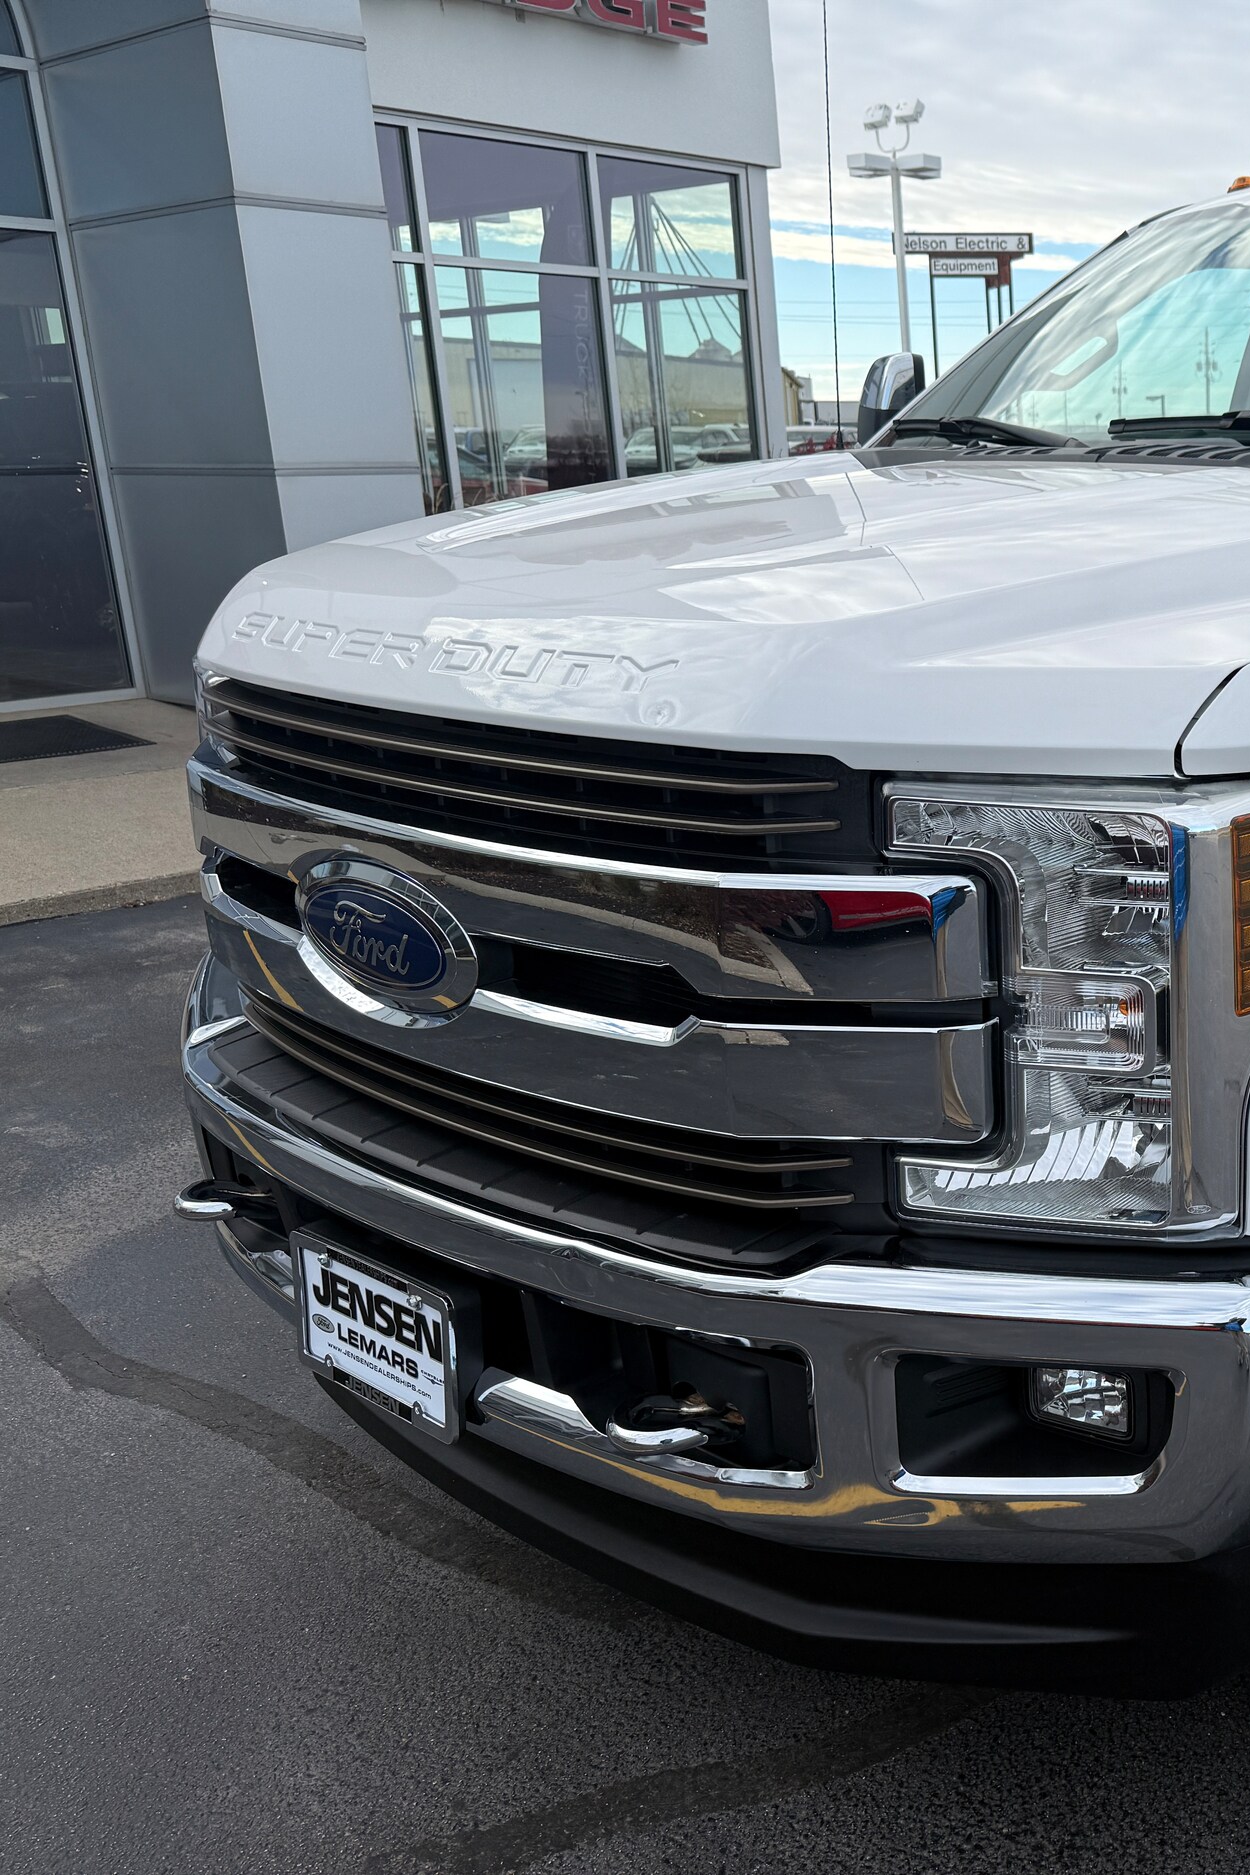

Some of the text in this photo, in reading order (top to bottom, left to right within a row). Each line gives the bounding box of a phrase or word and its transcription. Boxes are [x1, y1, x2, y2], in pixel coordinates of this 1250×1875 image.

[514, 0, 708, 44] GE
[933, 260, 996, 273] Equipment
[956, 237, 1008, 250] Electric
[1017, 237, 1027, 250] &
[232, 611, 681, 693] SUPER DUTY
[330, 900, 410, 976] Ford
[312, 1268, 443, 1363] JENSEN
[337, 1322, 419, 1379] LEMARS
[345, 1376, 400, 1415] JENSEN
